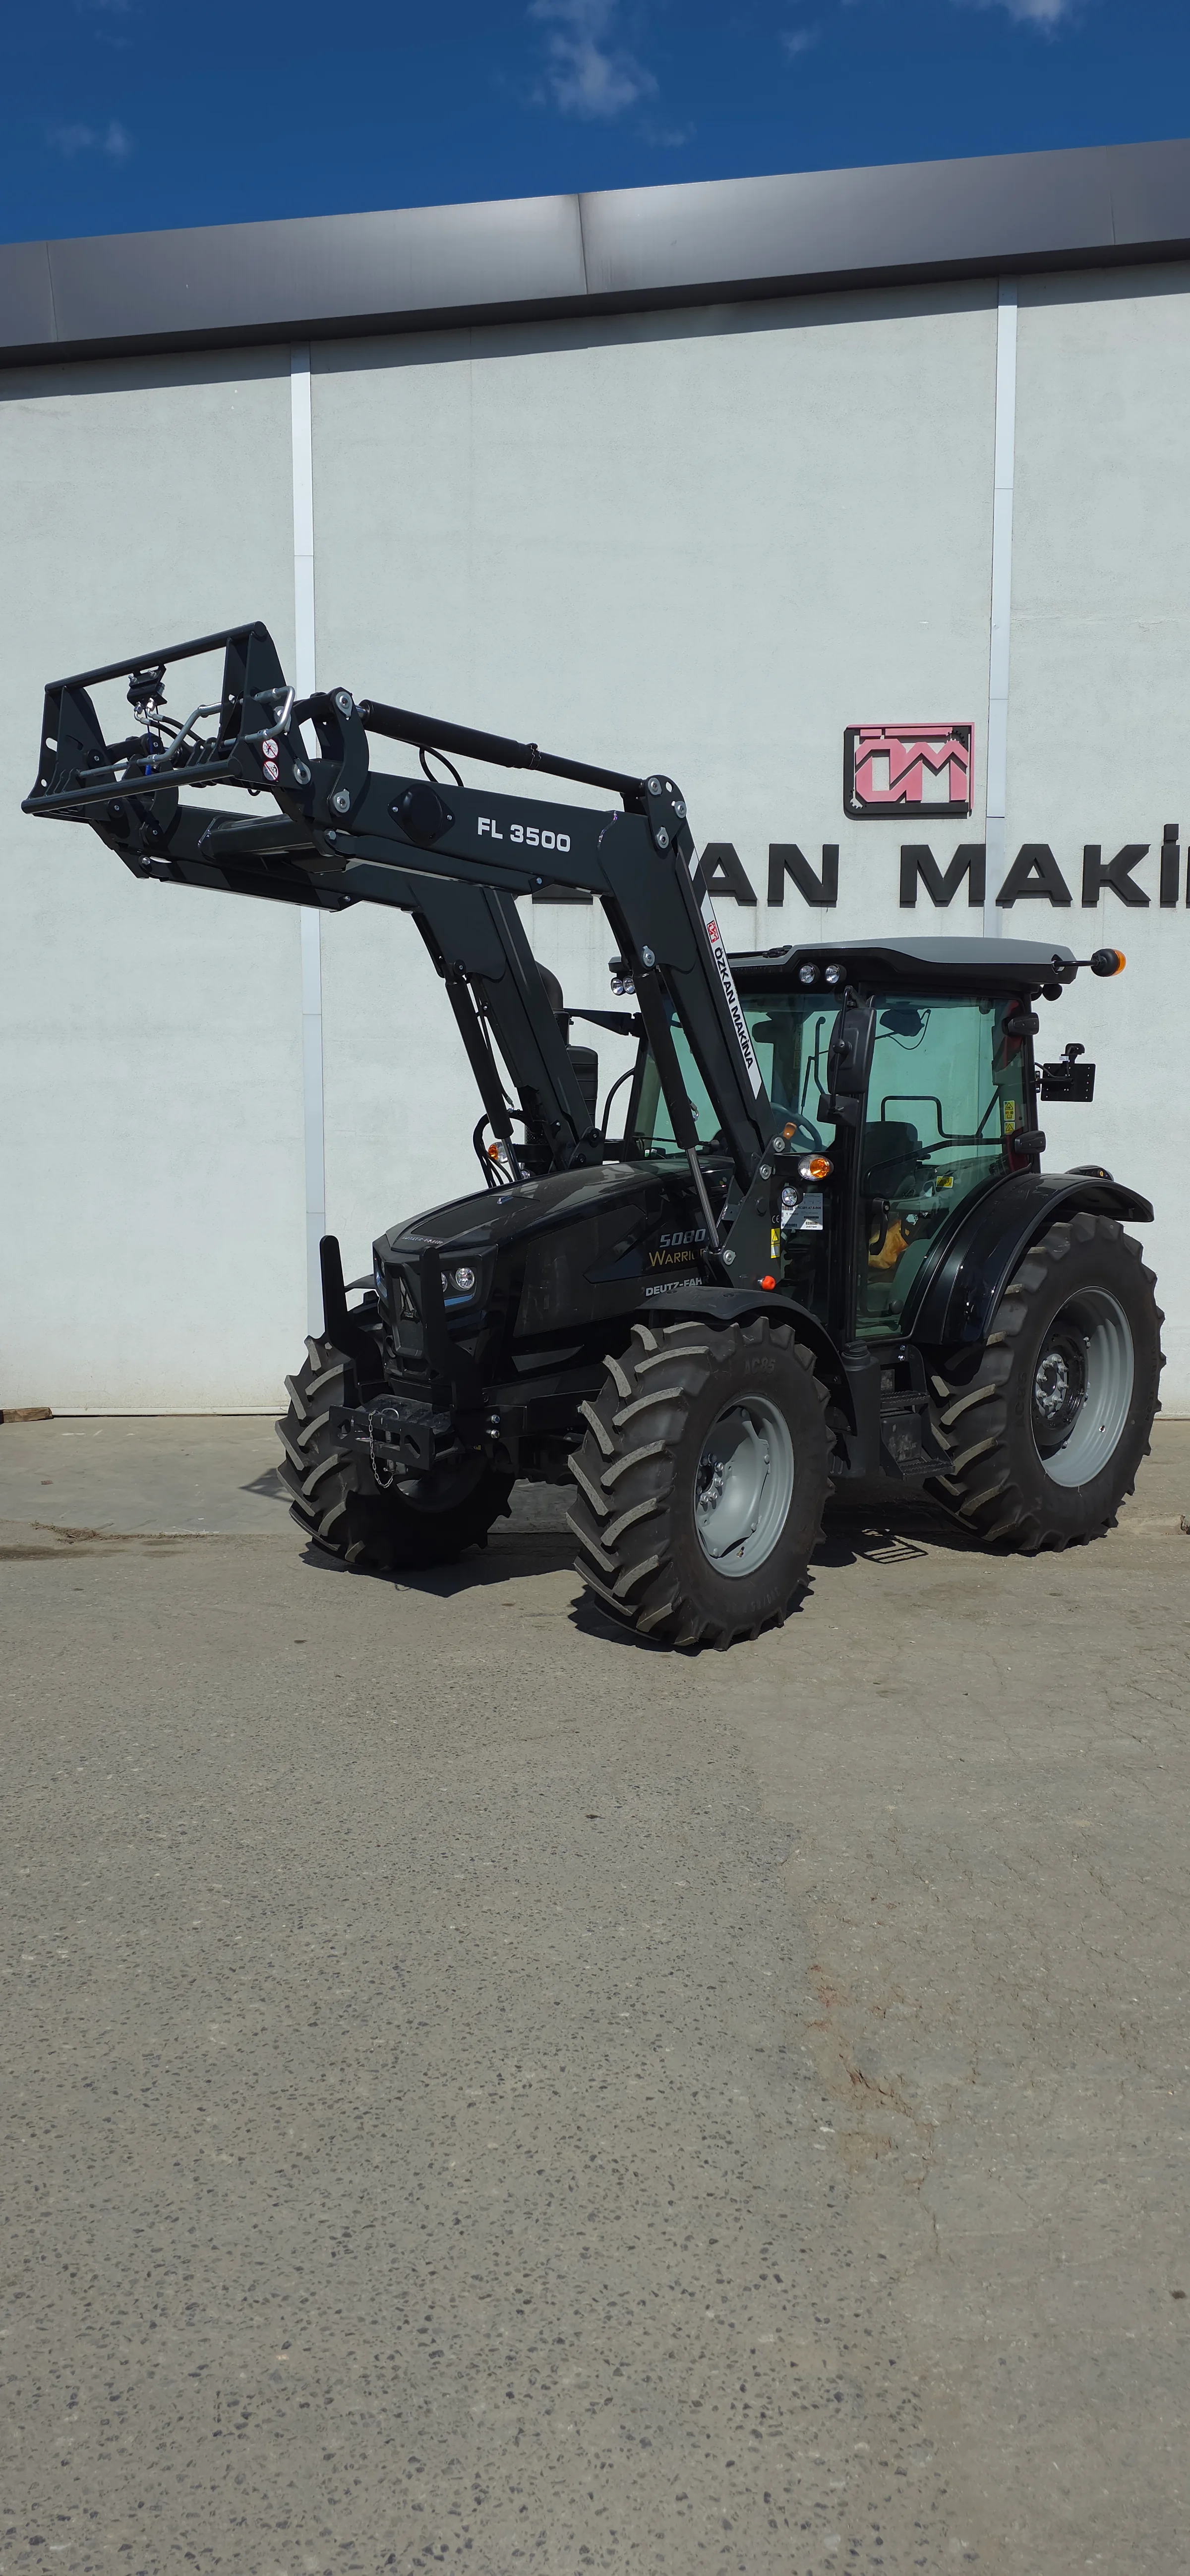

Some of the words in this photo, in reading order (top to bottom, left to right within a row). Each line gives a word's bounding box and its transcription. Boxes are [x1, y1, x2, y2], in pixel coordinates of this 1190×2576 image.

[477, 817, 503, 839] FL
[510, 824, 571, 852] 3500
[900, 824, 1190, 907] MAKİ
[714, 947, 735, 1004] ÖZKAN
[731, 1005, 753, 1070] MAKİNA
[659, 1229, 706, 1248] 5080
